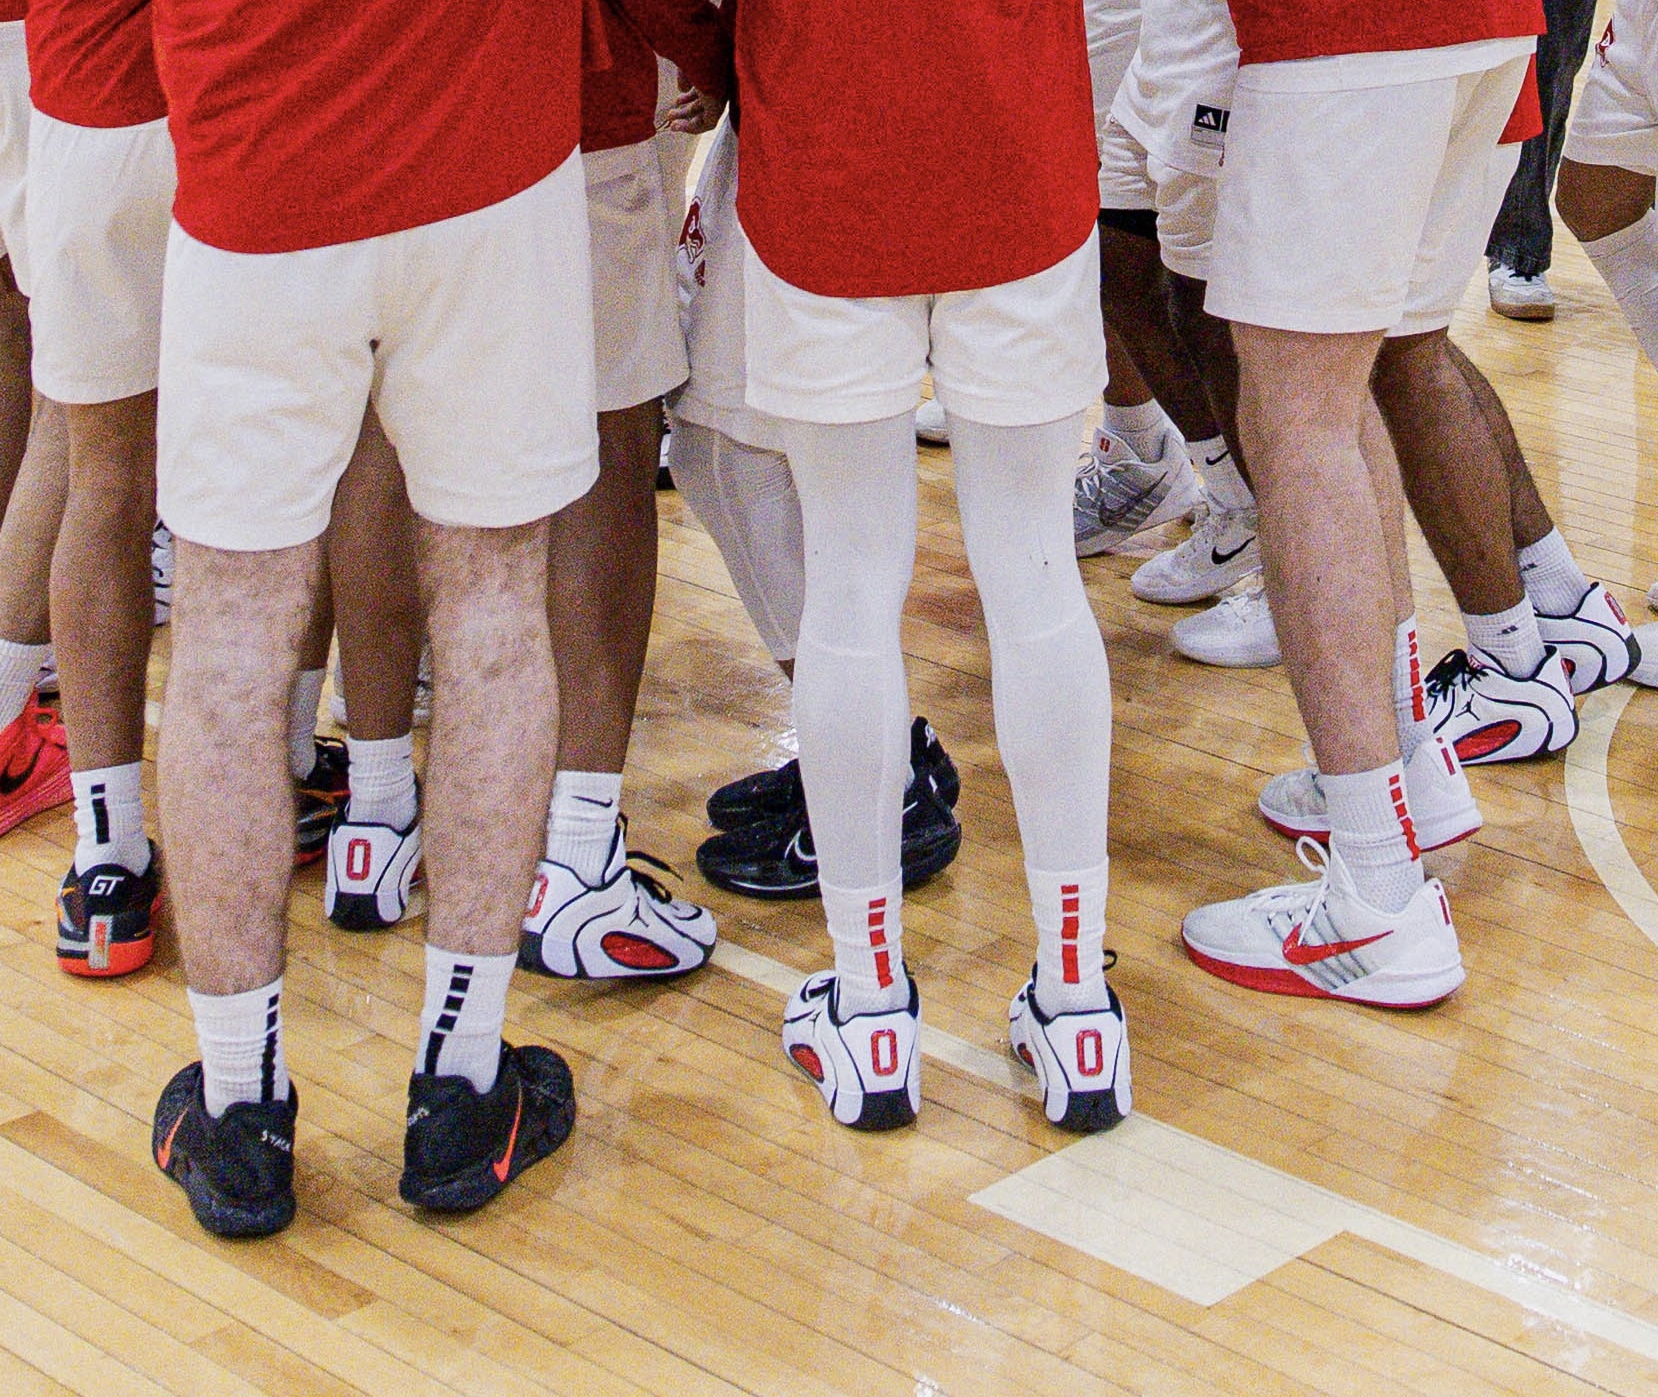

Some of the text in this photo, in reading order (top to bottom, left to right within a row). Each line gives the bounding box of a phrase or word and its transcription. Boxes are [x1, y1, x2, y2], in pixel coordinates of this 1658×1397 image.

[346, 838, 372, 881] 0
[88, 875, 126, 896] GT
[870, 1029, 898, 1077] 0
[1075, 1029, 1104, 1077] 0
